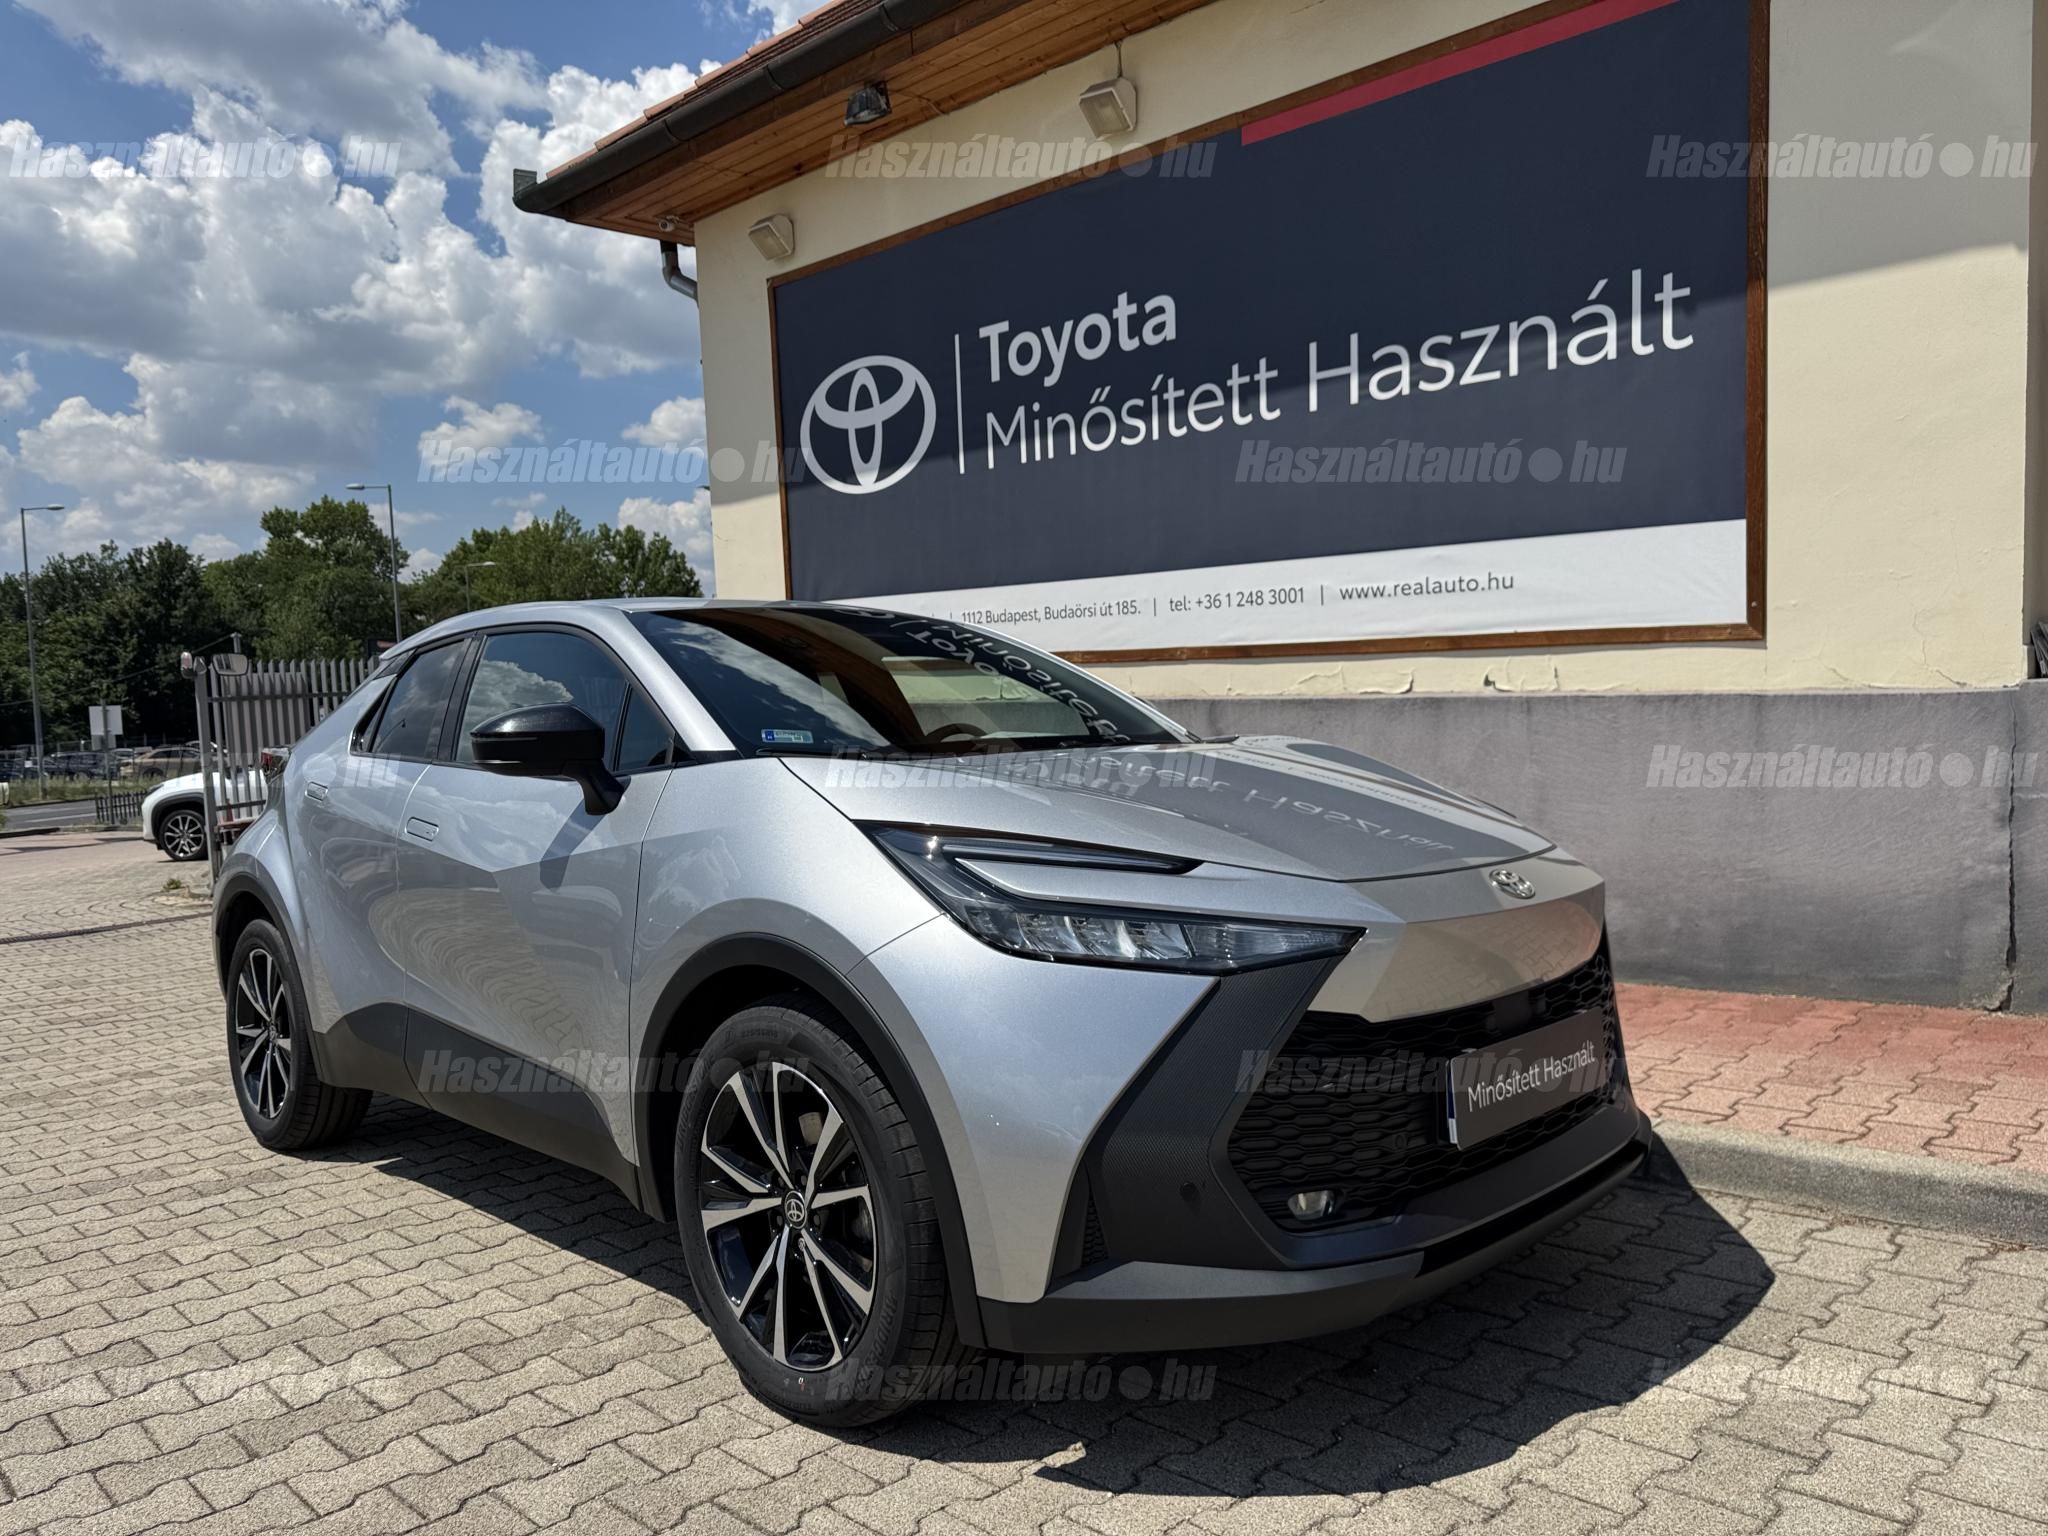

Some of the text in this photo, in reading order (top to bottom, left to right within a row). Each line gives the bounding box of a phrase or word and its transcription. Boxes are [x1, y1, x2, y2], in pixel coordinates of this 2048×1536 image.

[978, 291, 1177, 388] Toyota
[985, 268, 1695, 470] Minősített Használt
[985, 608, 1042, 626] Budapest,
[1044, 603, 1098, 621] Budaörsi
[1099, 600, 1114, 618] út
[1115, 599, 1142, 616] 185.
[1169, 595, 1192, 613] tel:
[1194, 592, 1223, 611] +36
[1235, 590, 1265, 608] 248
[1268, 587, 1305, 606] 3001
[1339, 571, 1515, 601] www.realauto.hu
[1467, 1039, 1596, 1113] Minősített Használt
